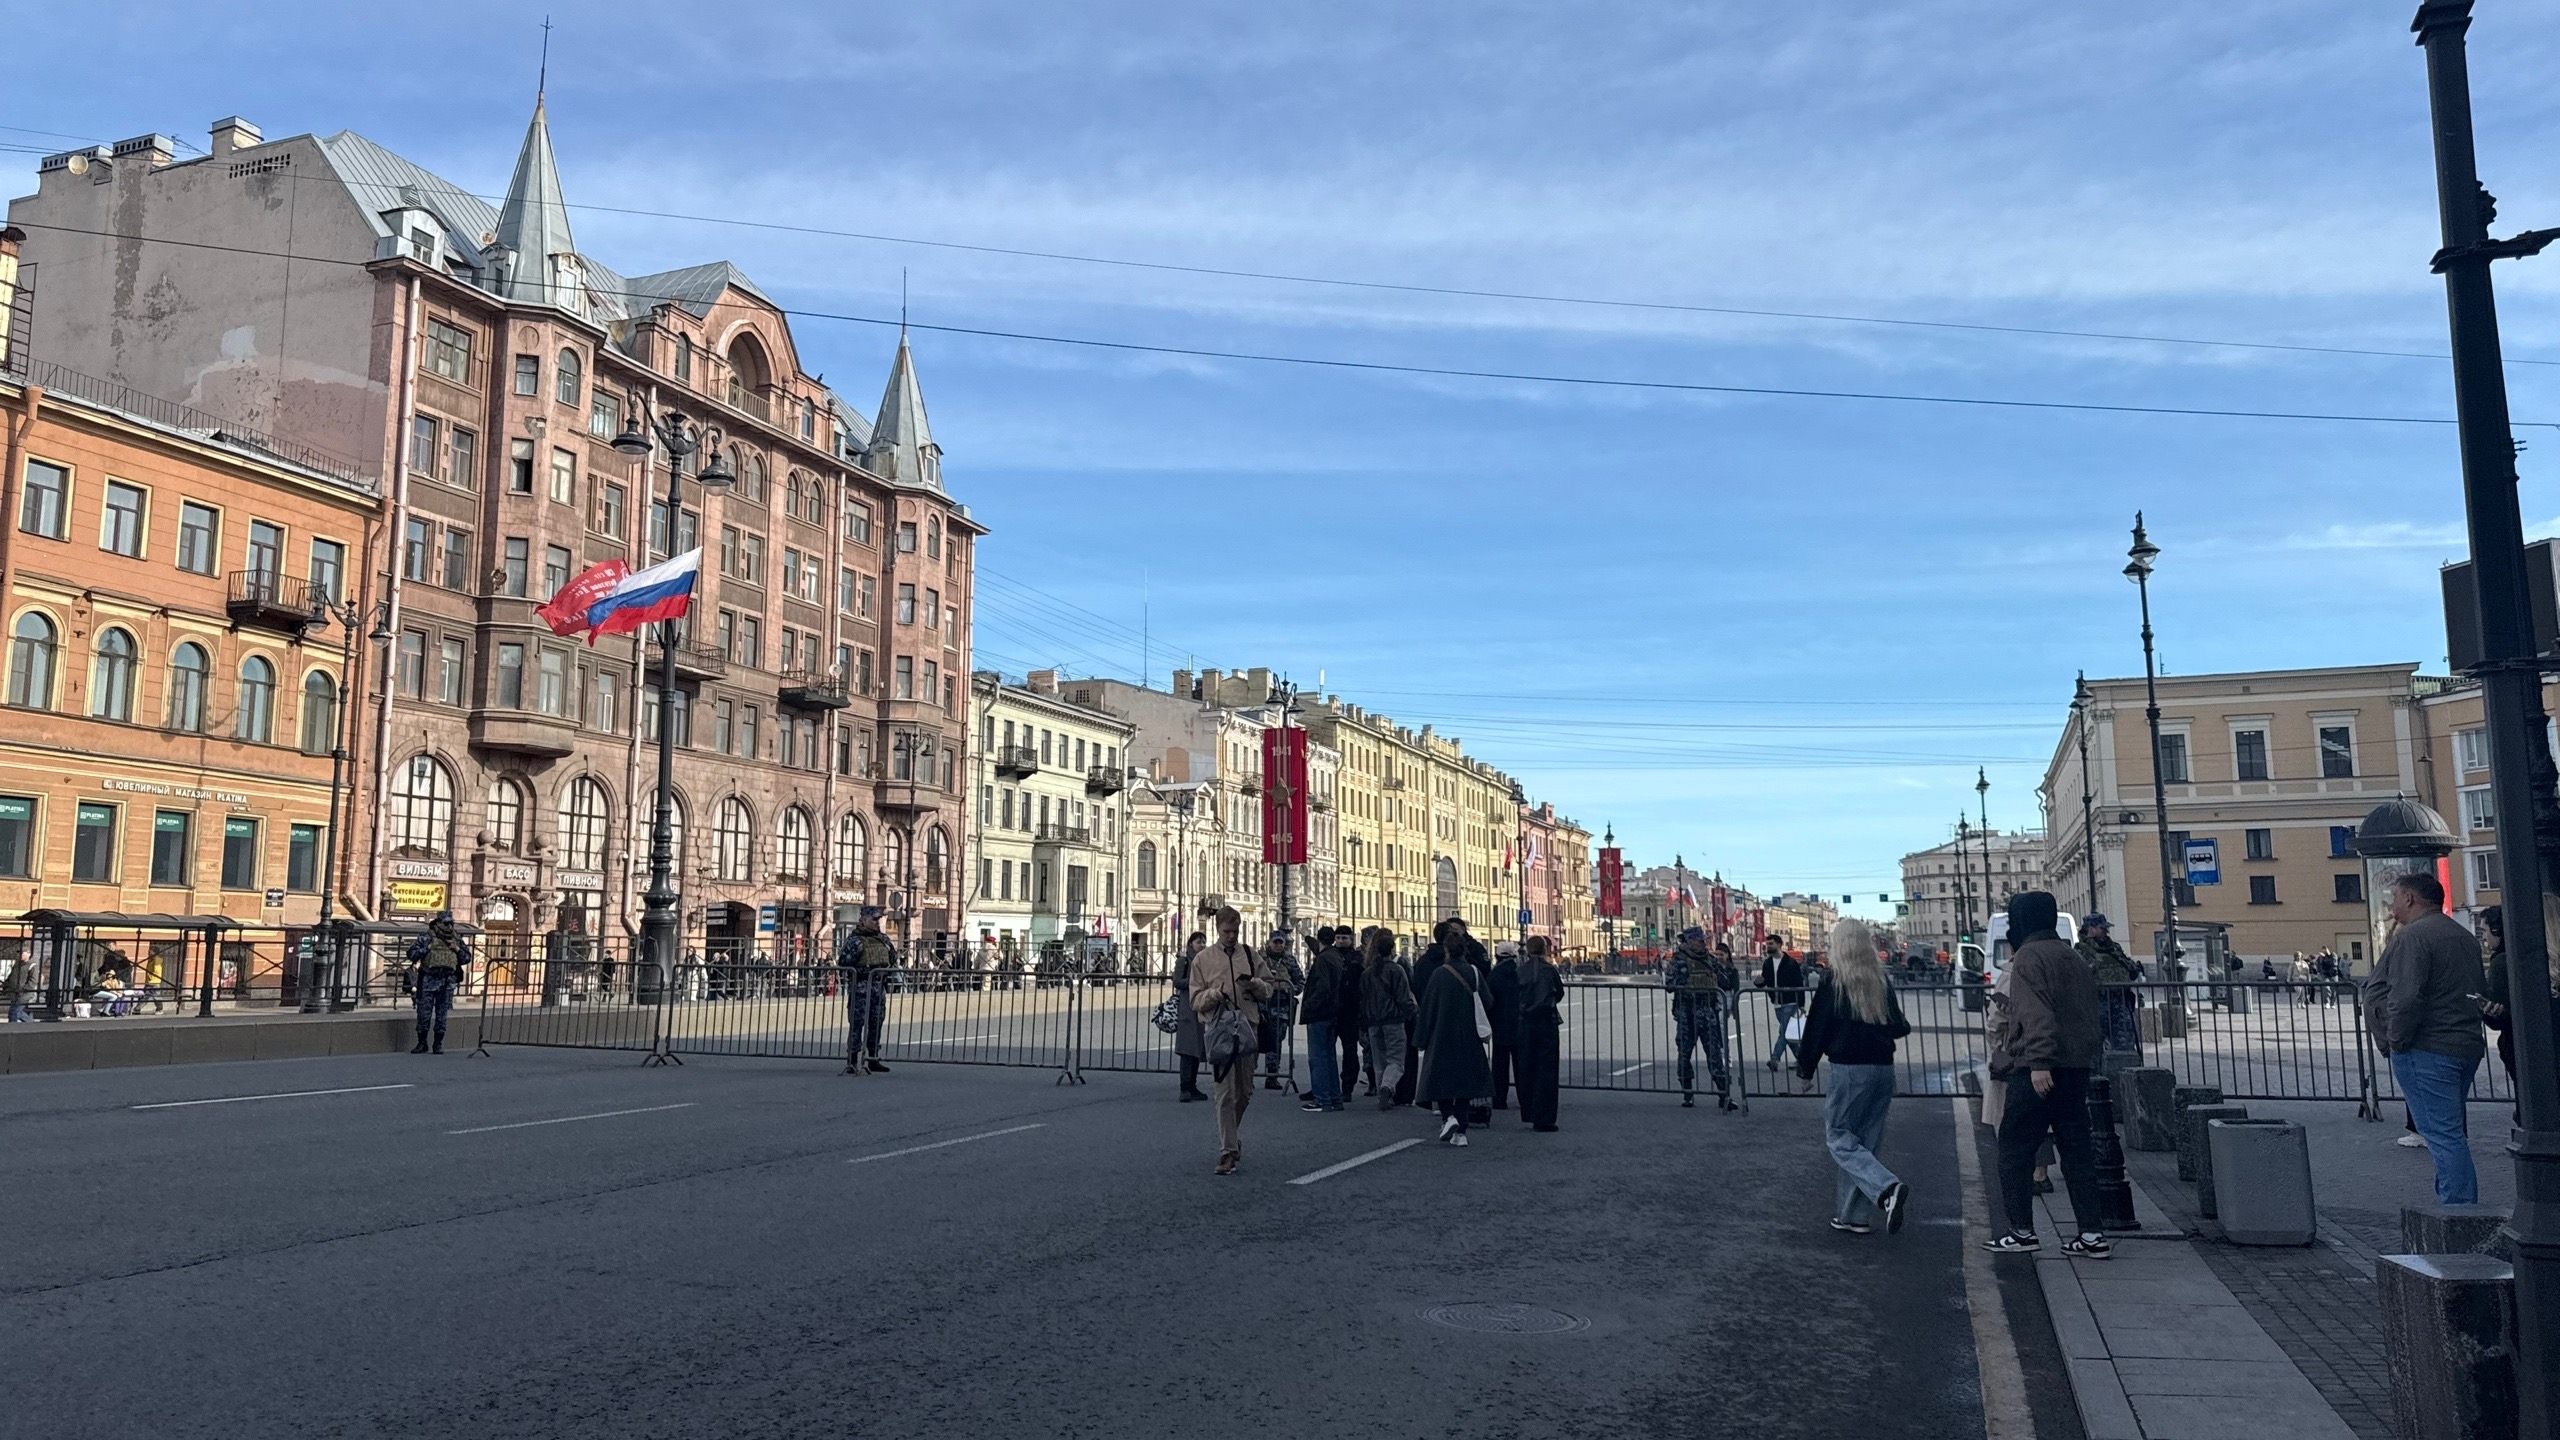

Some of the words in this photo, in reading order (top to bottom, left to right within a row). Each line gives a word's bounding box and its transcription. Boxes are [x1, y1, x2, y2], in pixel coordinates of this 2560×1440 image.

[1271, 745, 1291, 756] 1941
[115, 780, 170, 796] ЮВЕЛИРНЫЙ
[174, 788, 212, 800] МАГАЗИН
[216, 792, 247, 804] PLATINA
[1271, 832, 1293, 844] 1945
[398, 863, 442, 876] ВИЛЬЯМ
[505, 868, 531, 880] БАСС
[562, 875, 599, 887] ПИВНОЙ
[393, 888, 434, 896] ВКУСНЕЙШАЯ
[834, 890, 865, 901] ПРОДУКТЫ
[398, 897, 430, 905] ВЫПЕЧКА!
